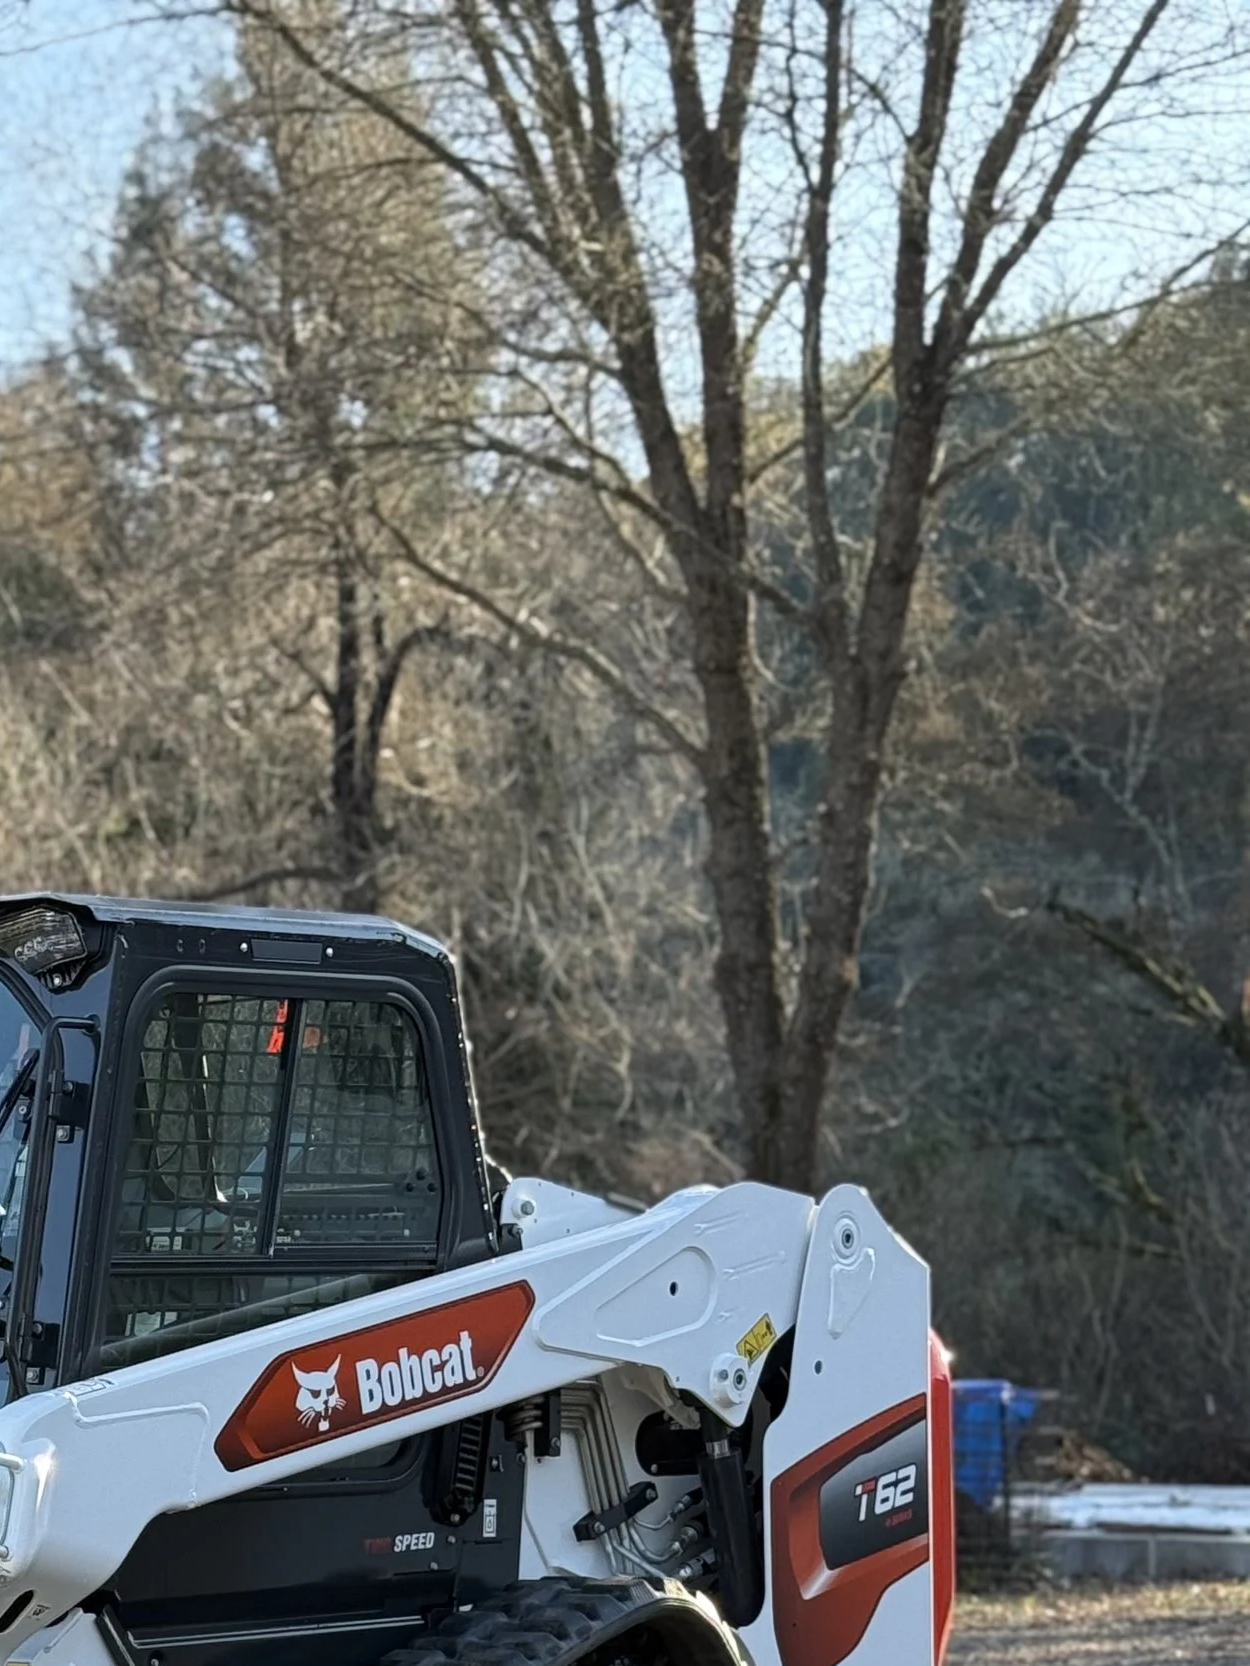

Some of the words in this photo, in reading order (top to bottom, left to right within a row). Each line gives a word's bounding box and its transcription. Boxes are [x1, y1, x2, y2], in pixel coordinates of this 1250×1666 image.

[355, 1330, 477, 1415] Bobcat
[854, 1464, 917, 1522] T62
[393, 1532, 435, 1552] SPEED
